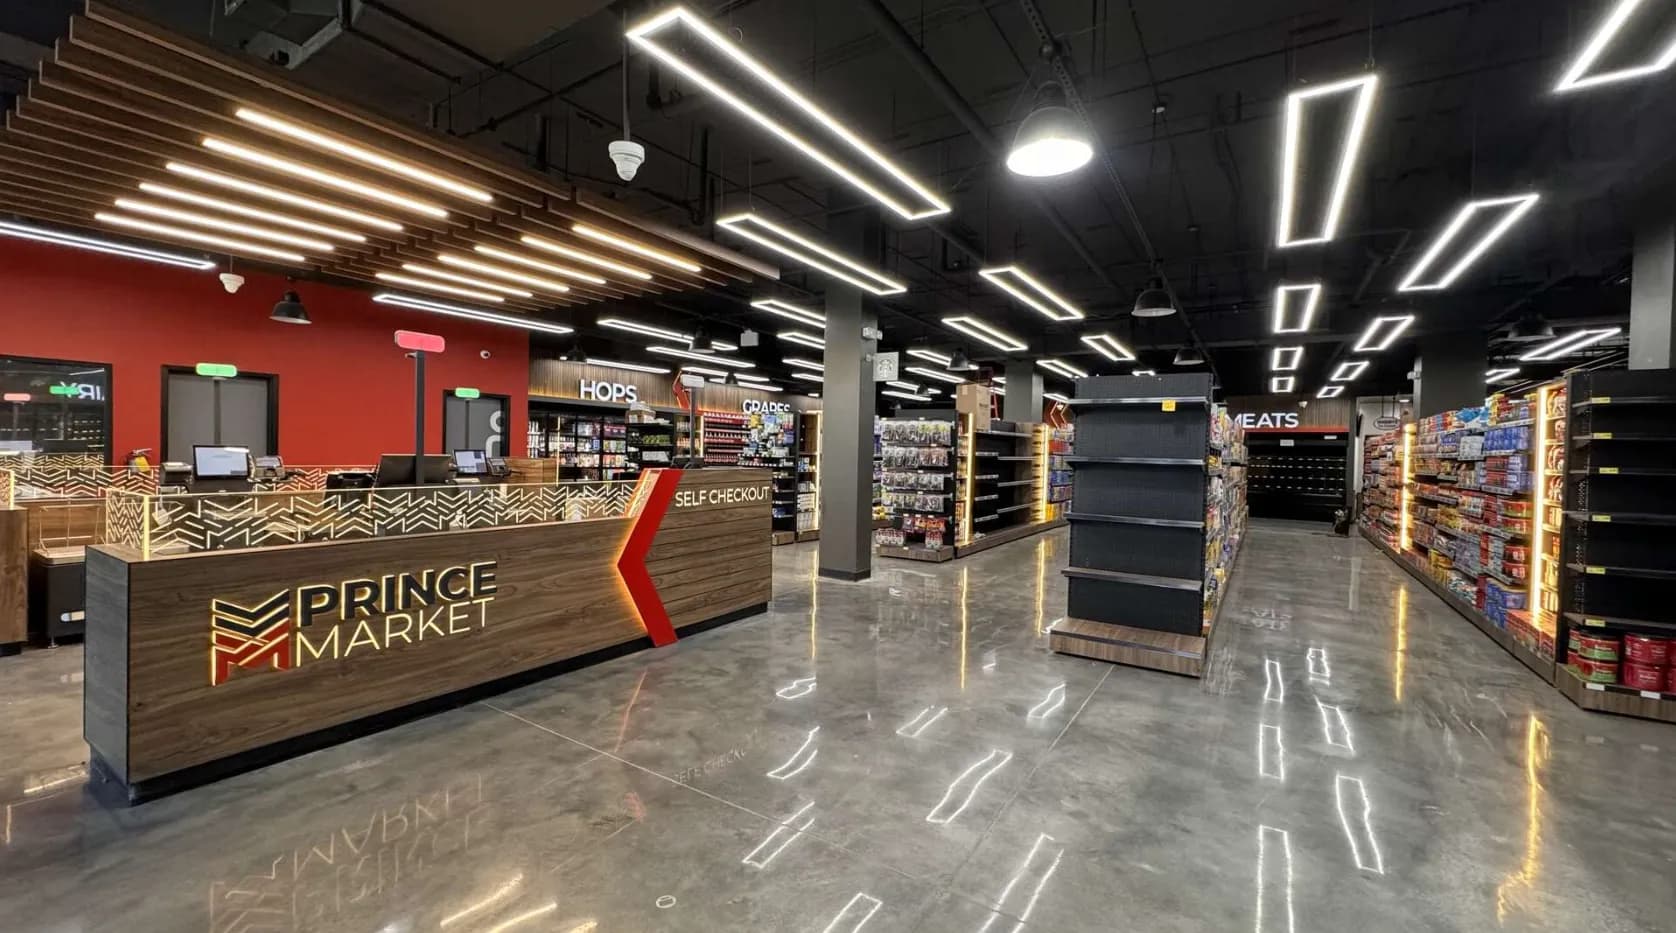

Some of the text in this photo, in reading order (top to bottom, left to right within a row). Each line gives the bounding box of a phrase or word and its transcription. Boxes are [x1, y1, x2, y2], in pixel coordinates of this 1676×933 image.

[580, 379, 638, 403] HOPS
[675, 485, 770, 507] SELF CHECKOUT
[297, 561, 498, 627] PRINCE
[296, 597, 495, 667] MARKET
